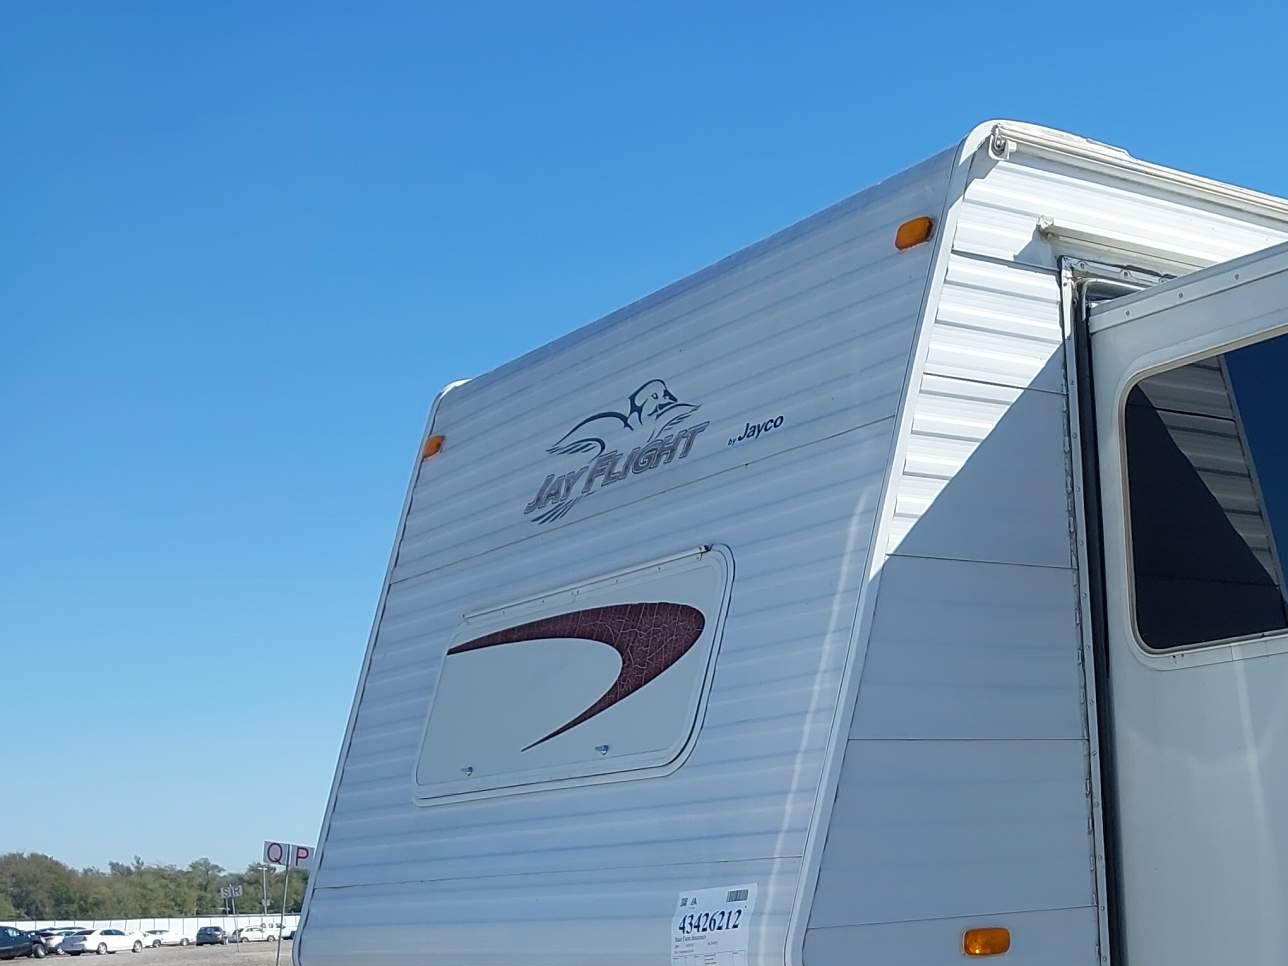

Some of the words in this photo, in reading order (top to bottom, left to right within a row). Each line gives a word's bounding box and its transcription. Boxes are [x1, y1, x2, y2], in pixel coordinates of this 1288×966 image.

[727, 436, 737, 446] by
[737, 415, 784, 442] Jayco
[523, 465, 588, 515] JAY
[581, 420, 711, 494] FLIGHT
[266, 842, 283, 865] Q
[295, 846, 309, 866] P
[678, 909, 742, 934] 43426212
